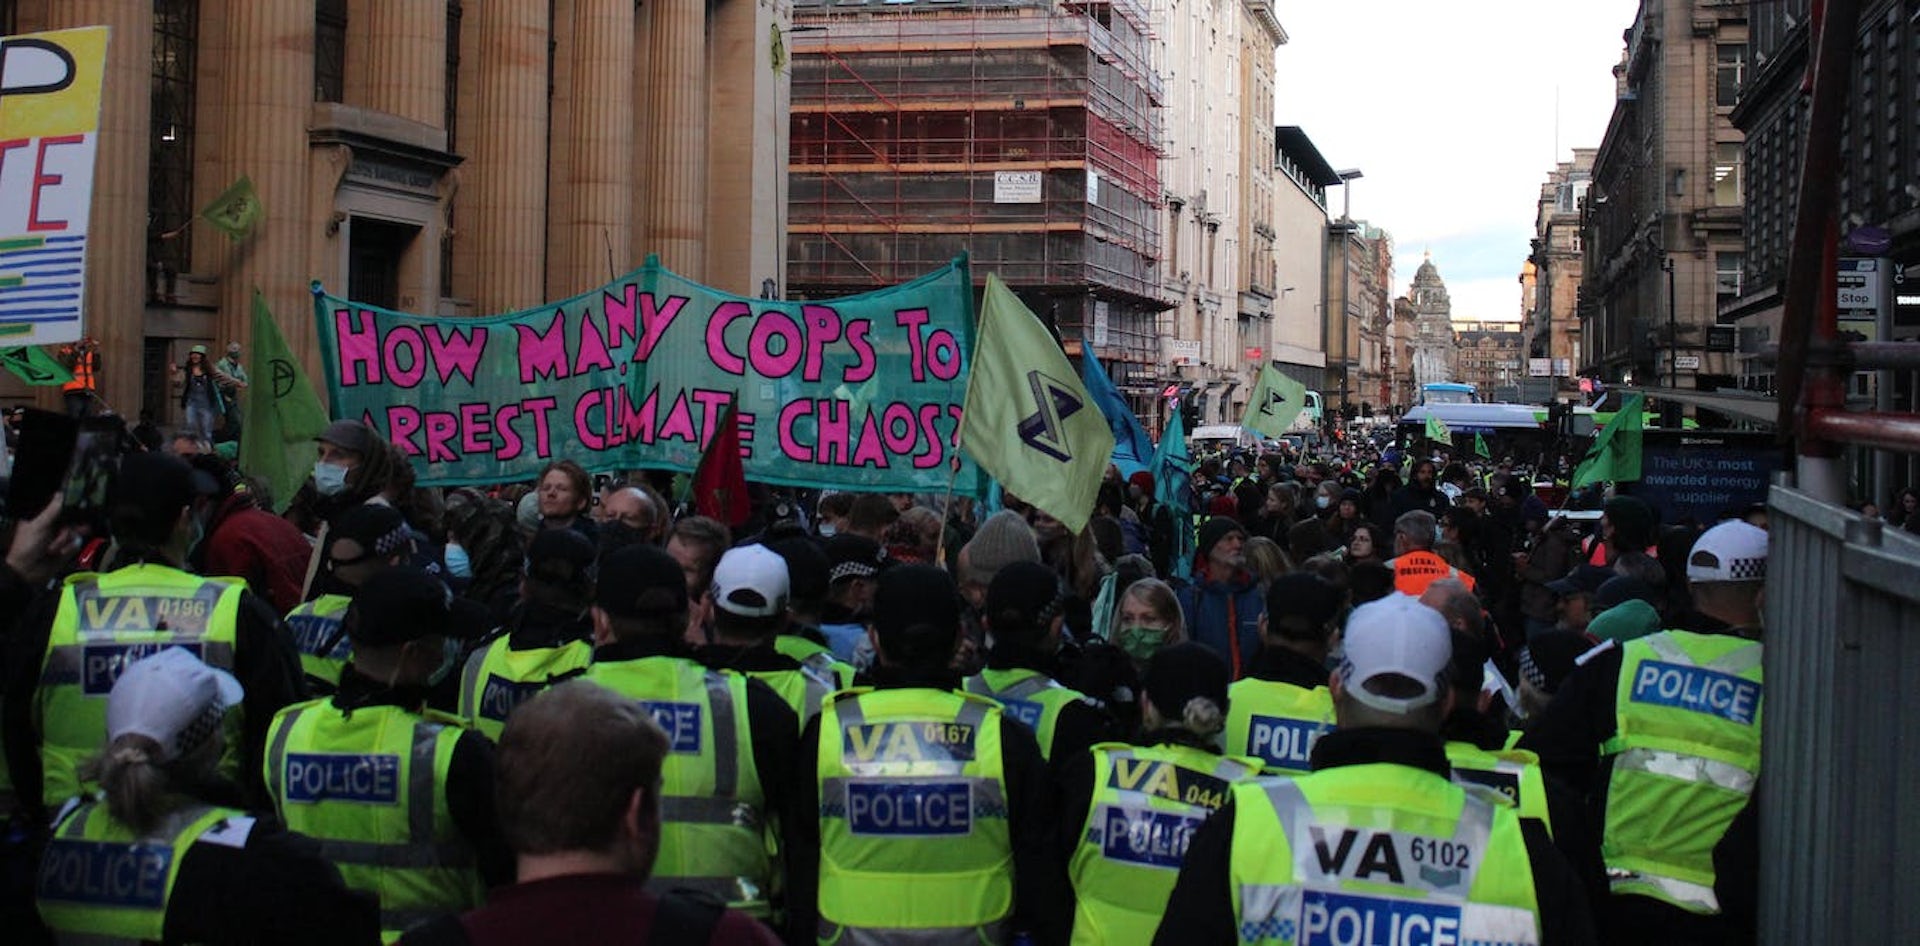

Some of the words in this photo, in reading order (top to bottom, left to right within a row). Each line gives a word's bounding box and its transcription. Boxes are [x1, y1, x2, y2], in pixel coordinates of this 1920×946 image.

[1841, 293, 1869, 304] Stop
[335, 309, 488, 388] HOW
[510, 283, 690, 384] MANY
[705, 301, 876, 382] COPS
[1646, 474, 1708, 486] awarded
[1711, 476, 1760, 489] energy
[1653, 456, 1679, 469] The
[1682, 457, 1714, 469] UK's
[1718, 459, 1755, 471] most
[1674, 491, 1730, 505] supplier
[1409, 557, 1436, 566] LEGAL
[84, 598, 151, 630] VA
[158, 600, 205, 617] 0196
[1636, 666, 1755, 717] POLICE
[848, 723, 923, 762] VA
[924, 723, 971, 745] 0167
[1252, 723, 1330, 763] POLI
[288, 760, 392, 794] POLICE
[1116, 757, 1180, 800] VA
[851, 791, 967, 828] POLICE
[38, 847, 164, 898] POLICE
[1308, 826, 1405, 884] VA
[1411, 836, 1469, 869] 6102
[1301, 901, 1459, 946] POLICE
